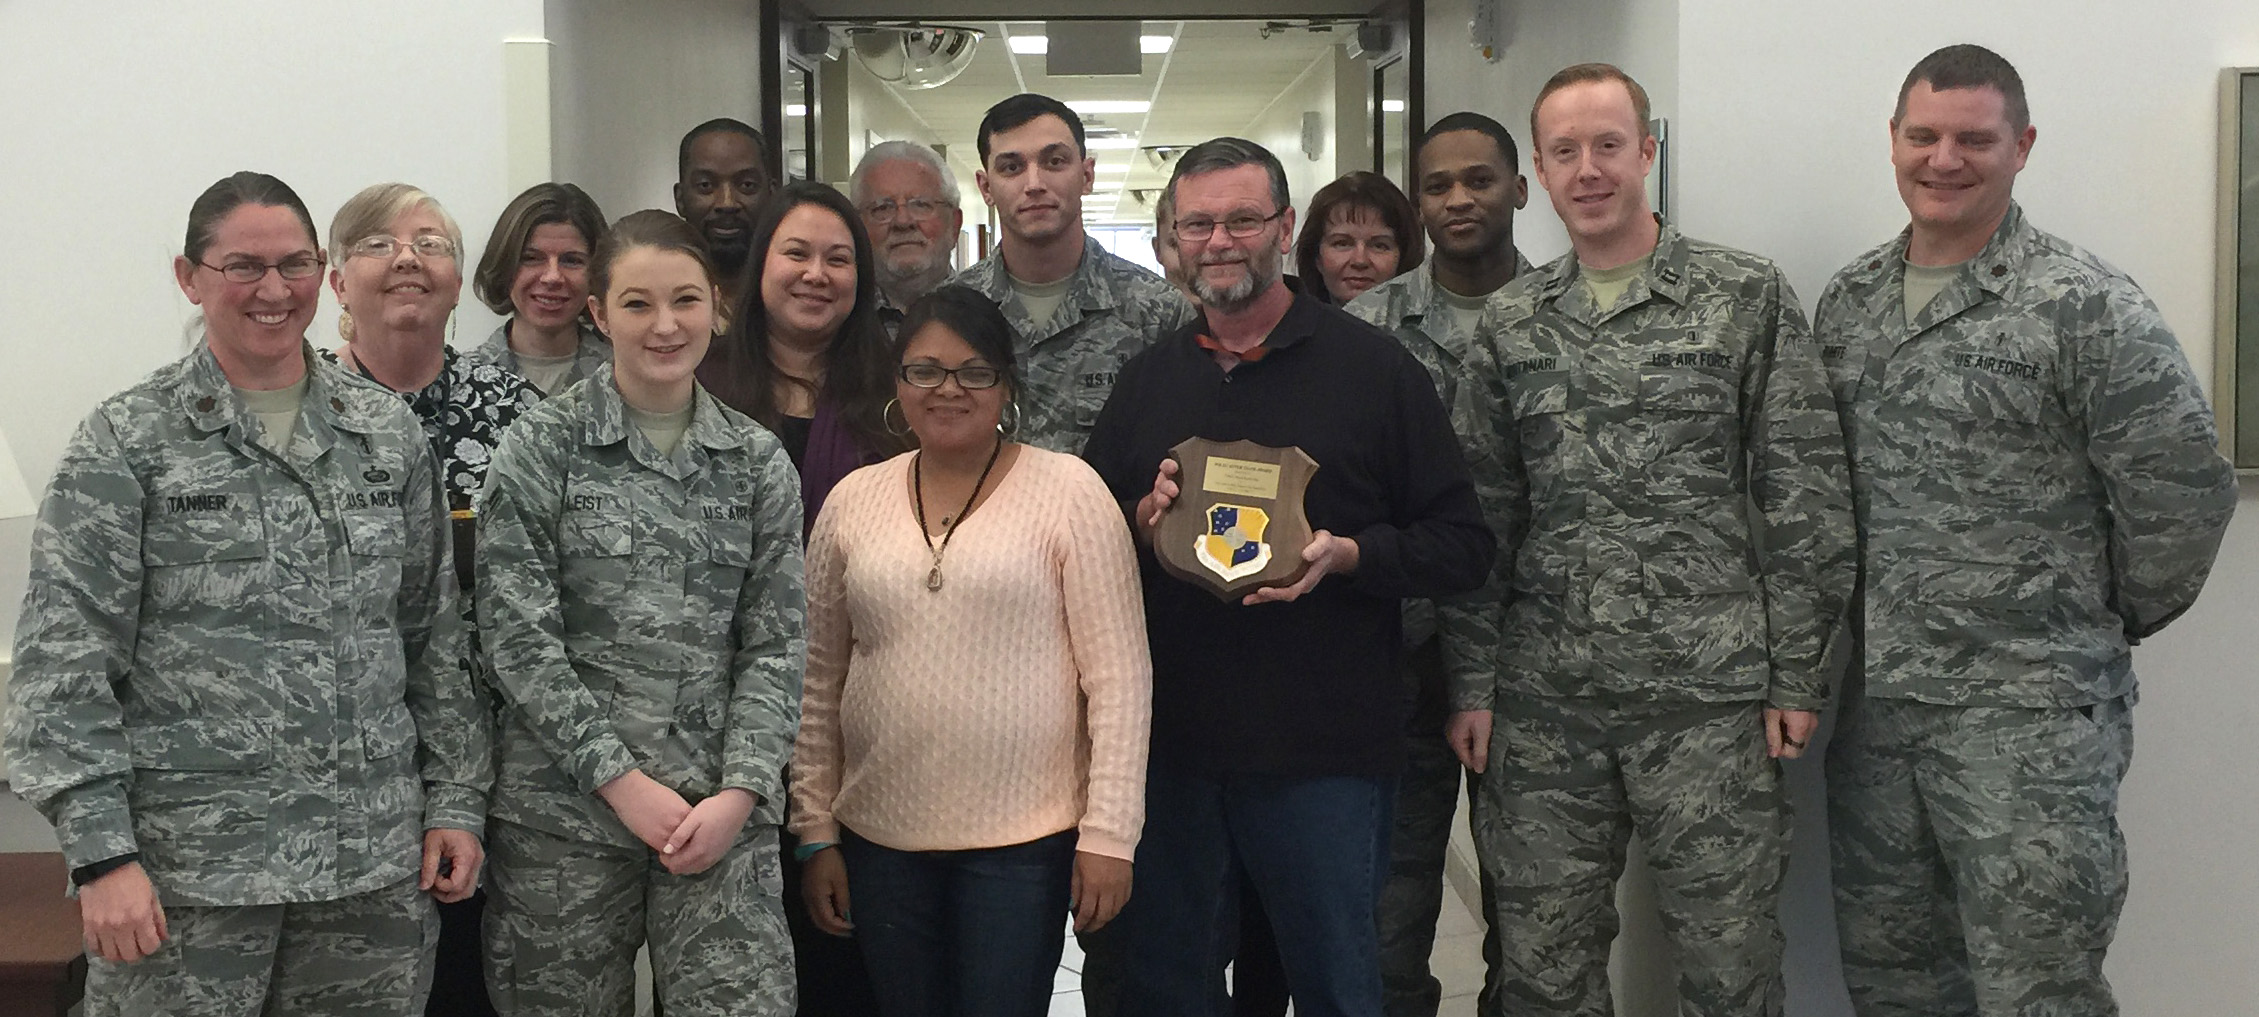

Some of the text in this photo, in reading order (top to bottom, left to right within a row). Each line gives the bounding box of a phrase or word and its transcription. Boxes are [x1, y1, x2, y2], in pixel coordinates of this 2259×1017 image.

[1675, 352, 1698, 366] AIR
[1700, 352, 1733, 369] FORCE
[1974, 355, 1997, 372] AIR
[1998, 359, 2041, 380] FORCE
[167, 494, 227, 513] TANNER
[369, 491, 392, 508] AIR
[566, 495, 603, 511] LEIST
[728, 505, 748, 522] AIR
